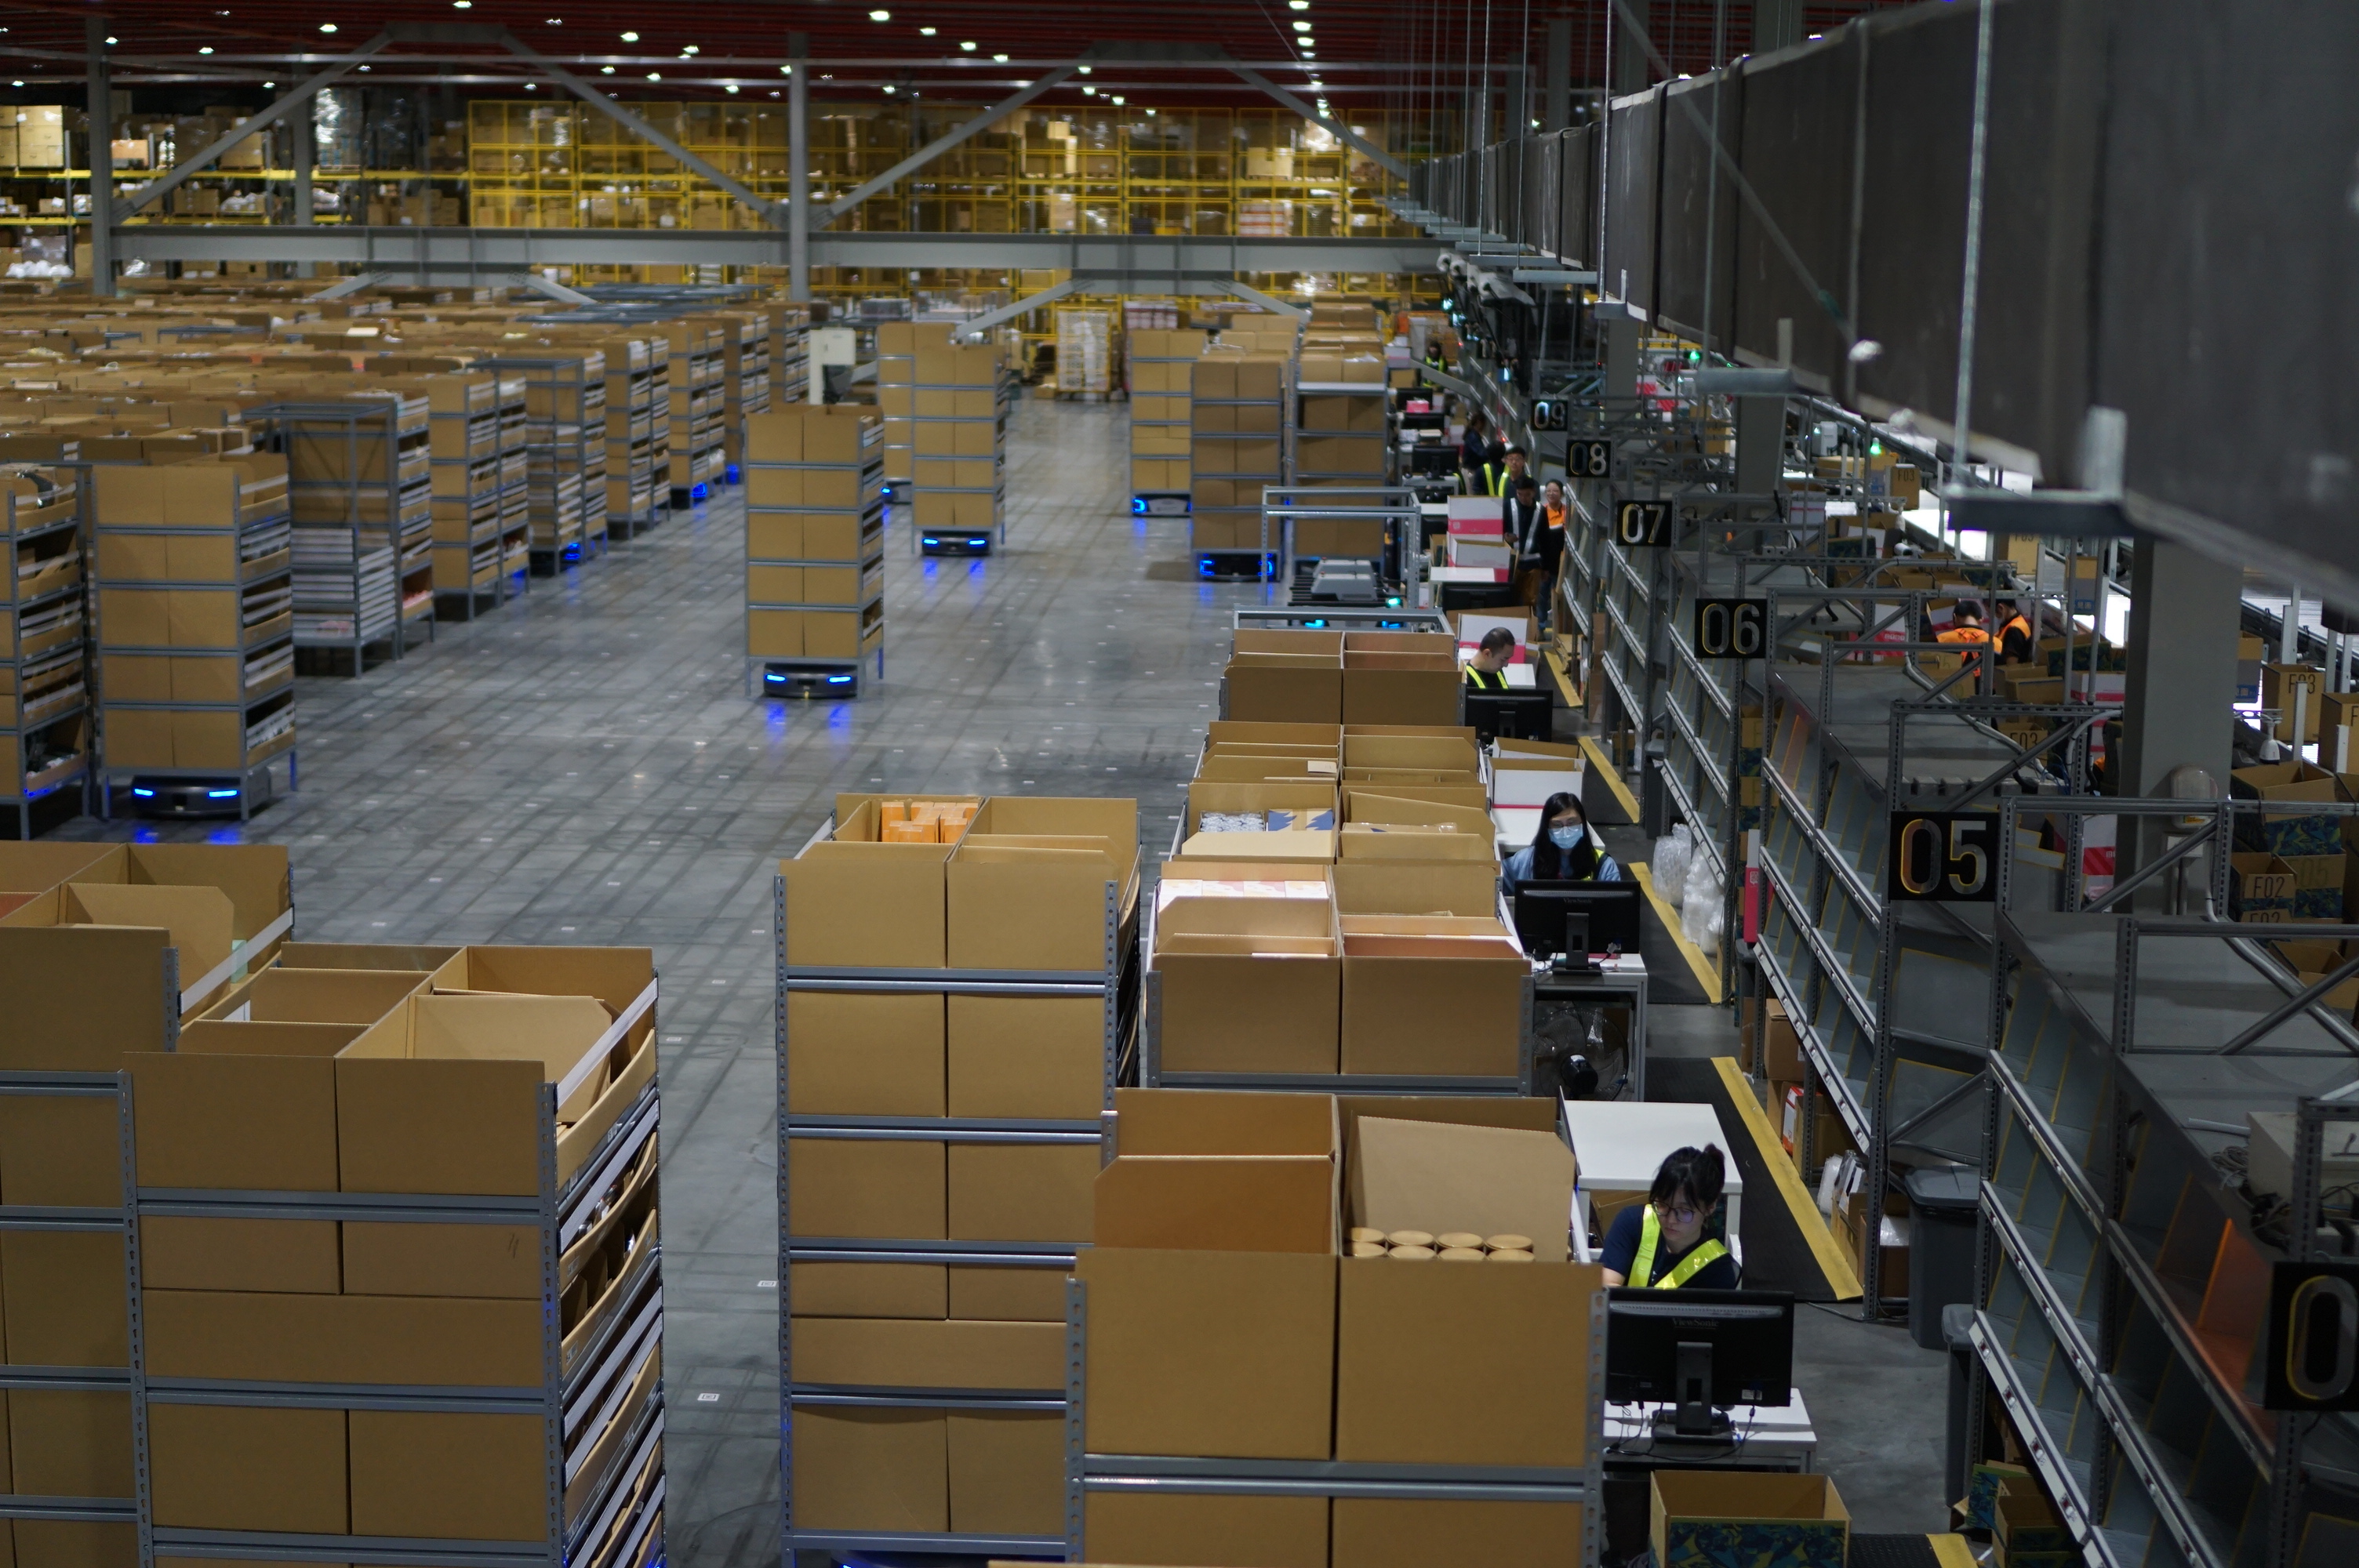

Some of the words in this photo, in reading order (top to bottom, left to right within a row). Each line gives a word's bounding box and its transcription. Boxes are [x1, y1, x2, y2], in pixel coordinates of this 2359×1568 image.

[1534, 401, 1565, 430] 09
[1570, 442, 1606, 475] 08
[1898, 469, 1915, 482] F03
[1623, 503, 1666, 543] 07
[1702, 603, 1760, 655] 06
[1900, 818, 1987, 894] 05
[2253, 876, 2285, 898] F02
[1672, 1317, 1720, 1327] ViewSonic
